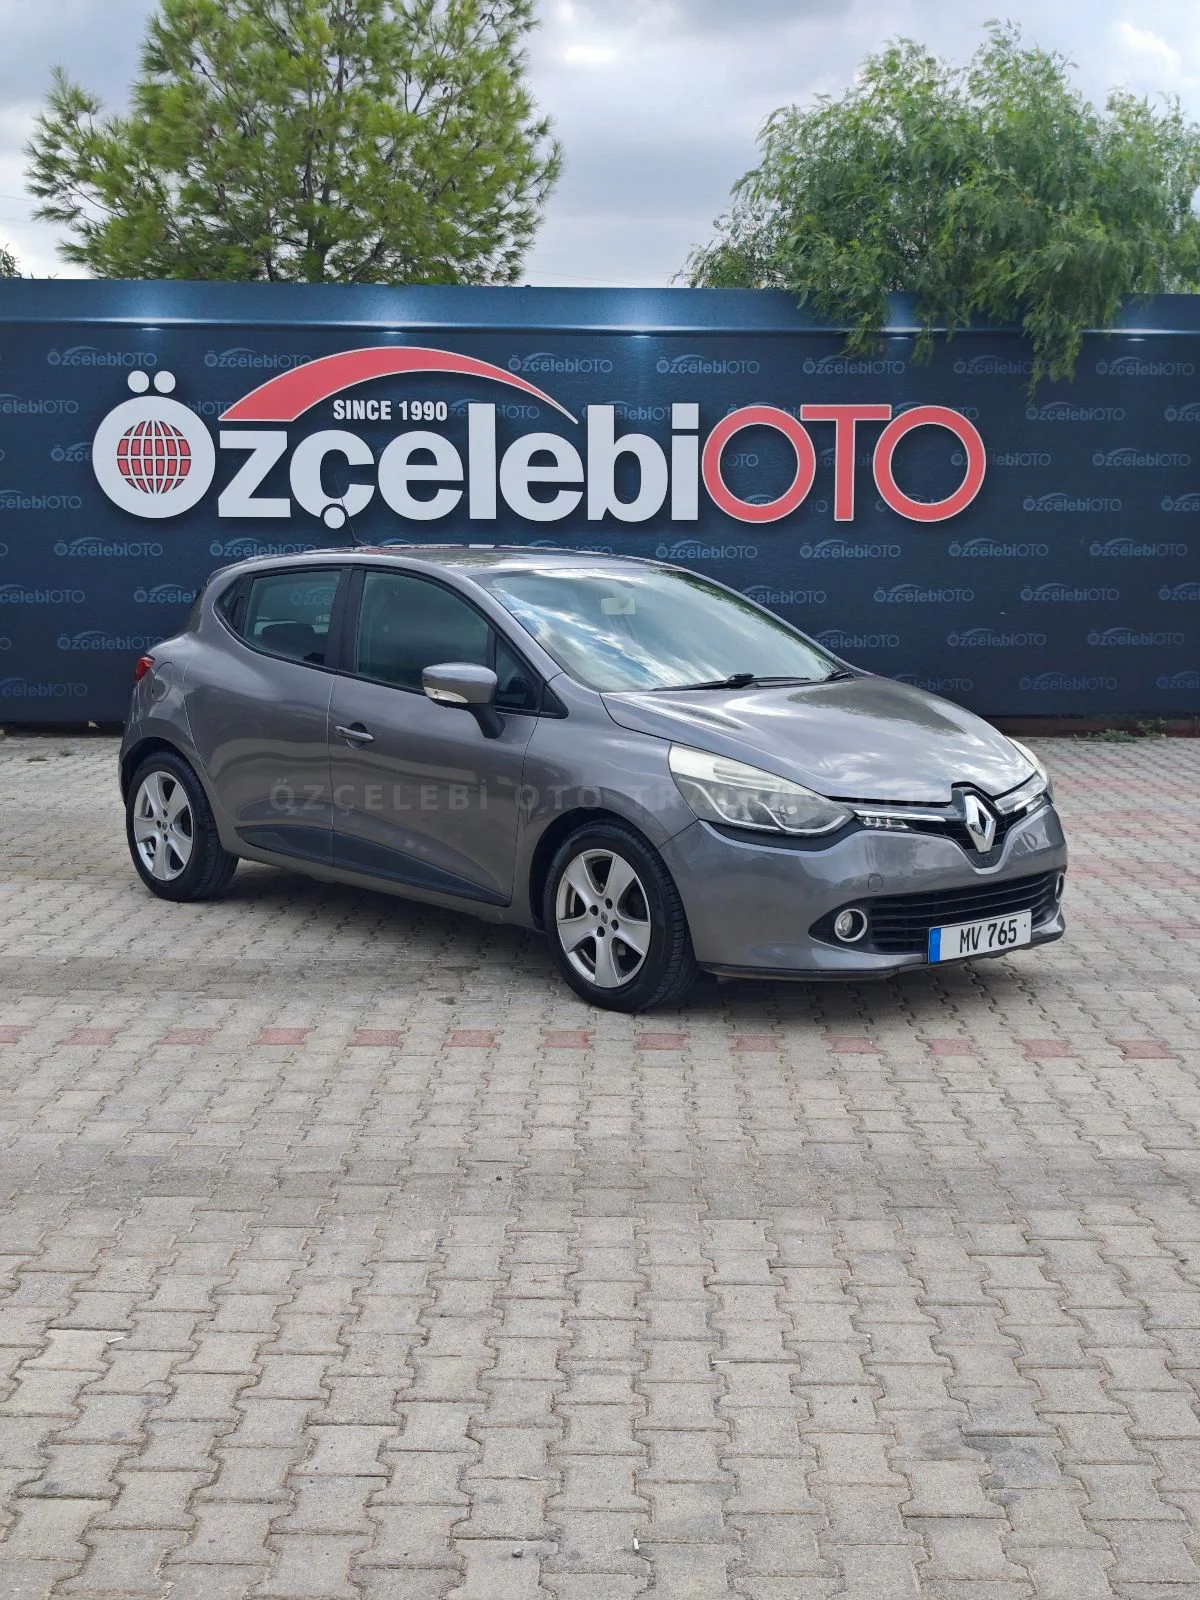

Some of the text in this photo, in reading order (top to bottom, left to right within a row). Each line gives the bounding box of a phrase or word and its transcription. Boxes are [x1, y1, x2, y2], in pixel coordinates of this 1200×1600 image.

[333, 399, 448, 421] SINCE 1990
[92, 370, 987, 529] ÖzçelebiOTO
[959, 918, 1018, 954] MV 765
